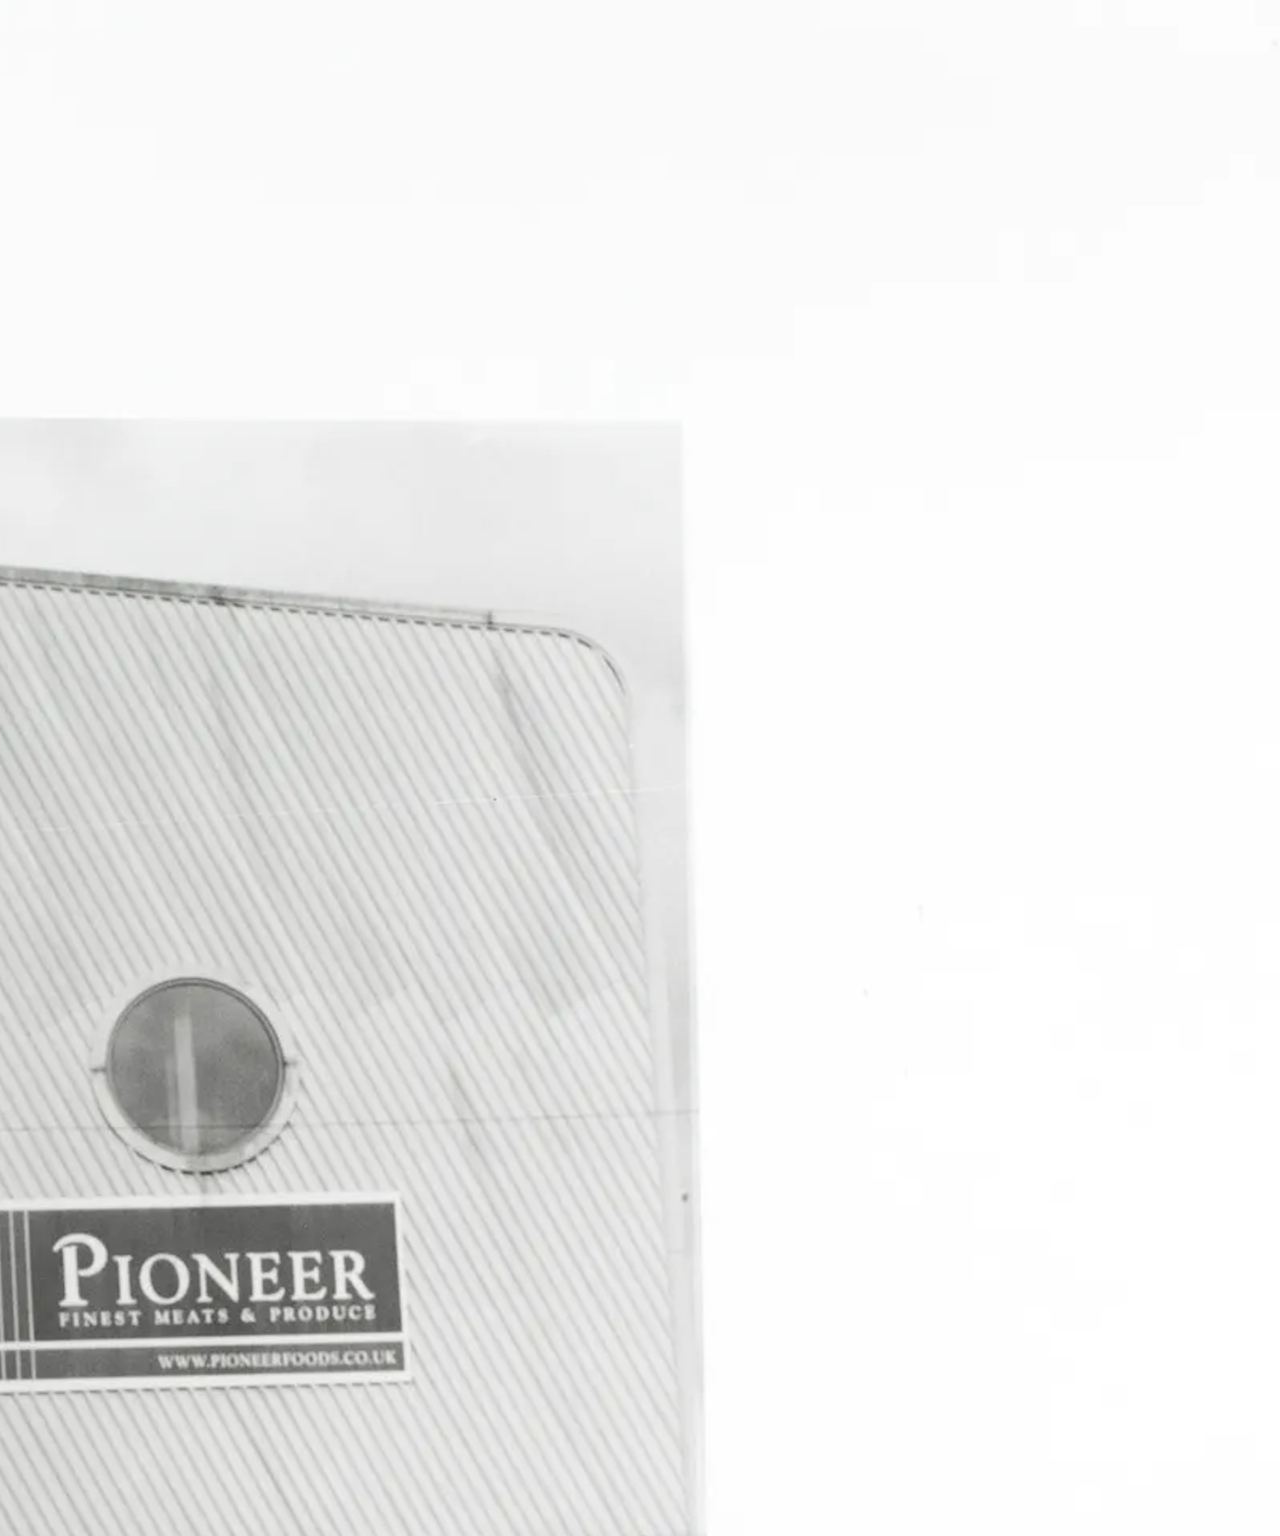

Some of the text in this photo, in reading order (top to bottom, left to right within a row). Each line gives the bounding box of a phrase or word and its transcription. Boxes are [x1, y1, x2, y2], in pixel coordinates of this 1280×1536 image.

[52, 1233, 376, 1308] PIONEER
[58, 1304, 377, 1328] FINEST MEATS & PRODUCE
[157, 1350, 397, 1370] WWW.PIONEERFOODS.CO.UK
